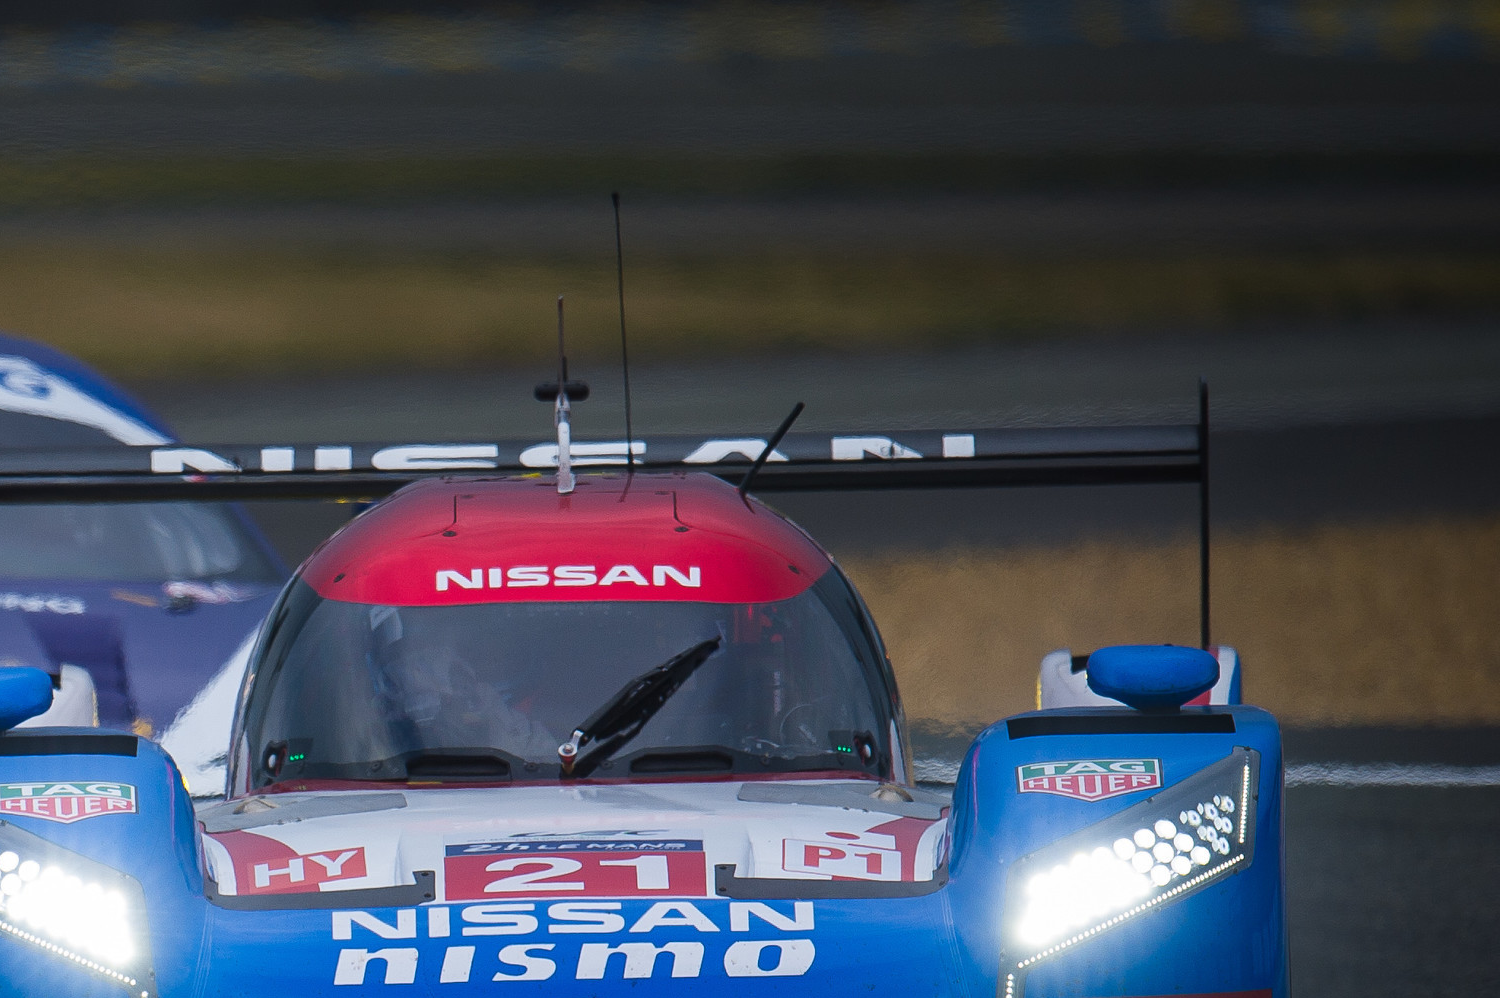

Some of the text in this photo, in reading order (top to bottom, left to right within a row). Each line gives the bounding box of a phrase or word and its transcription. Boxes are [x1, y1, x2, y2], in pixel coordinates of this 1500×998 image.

[435, 565, 701, 591] NISSAN
[1030, 761, 1146, 775] TAG
[7, 784, 122, 797] TAG
[1027, 774, 1152, 797] HEUER
[4, 797, 128, 819] HEUER
[253, 849, 359, 888] HY
[803, 844, 882, 876] P1
[483, 854, 670, 893] 21
[332, 900, 817, 941] NISSAN
